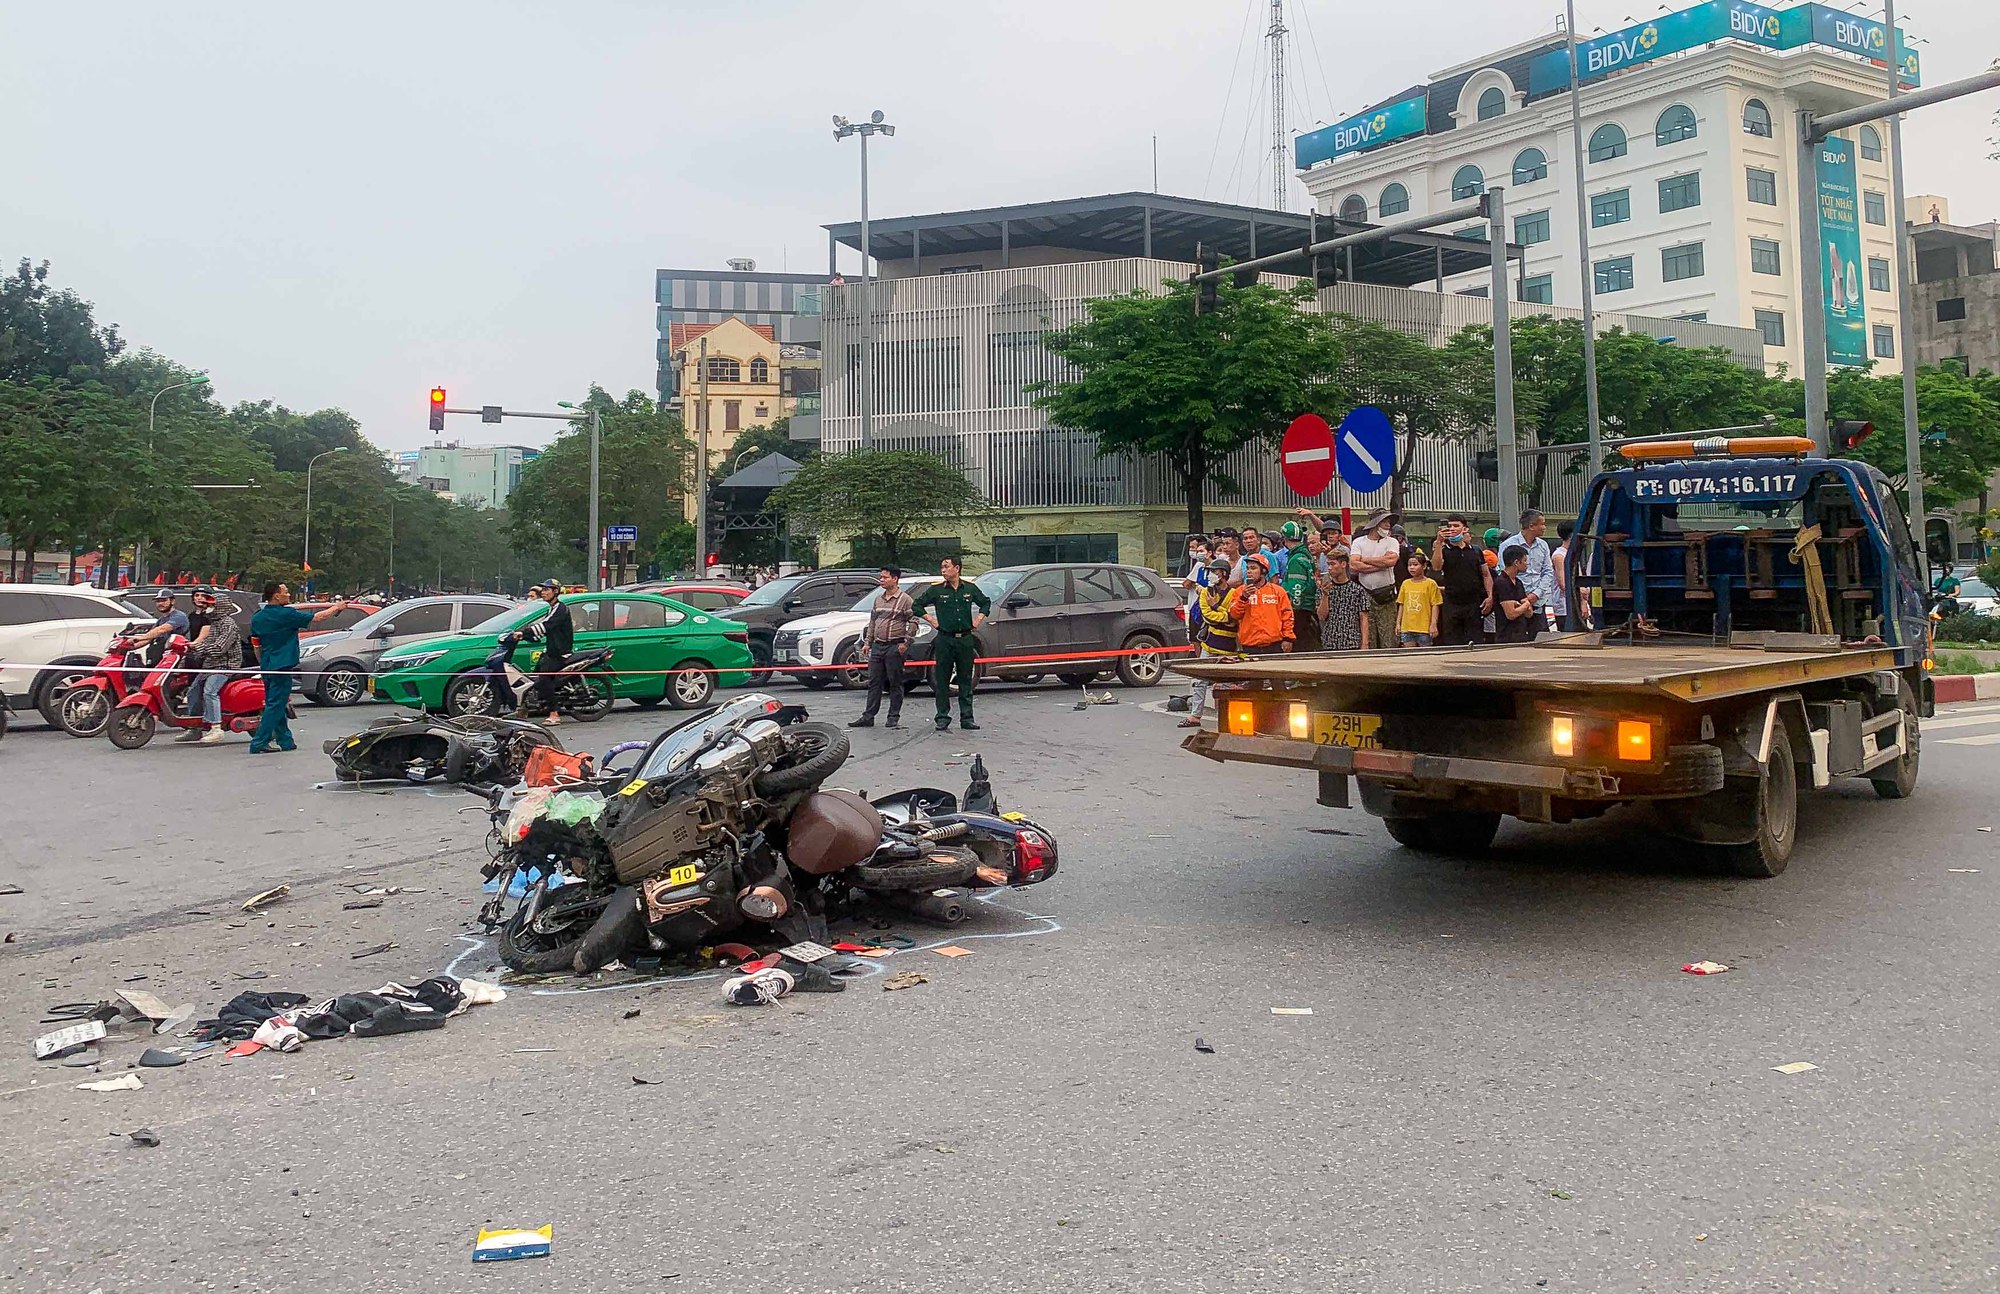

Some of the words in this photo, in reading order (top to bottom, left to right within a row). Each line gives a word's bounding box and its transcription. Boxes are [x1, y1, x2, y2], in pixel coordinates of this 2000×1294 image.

[1730, 9, 1767, 38] BIDV
[1835, 20, 1871, 50] BIDV
[1588, 35, 1640, 72] BIDV
[1334, 121, 1373, 151] BIDV
[1822, 150, 1840, 164] BIDV
[1668, 474, 1796, 496] 0974.116.117
[1293, 583, 1302, 606] Grab
[1331, 715, 1362, 733] 29H
[626, 782, 642, 792] 11
[675, 867, 693, 882] 10
